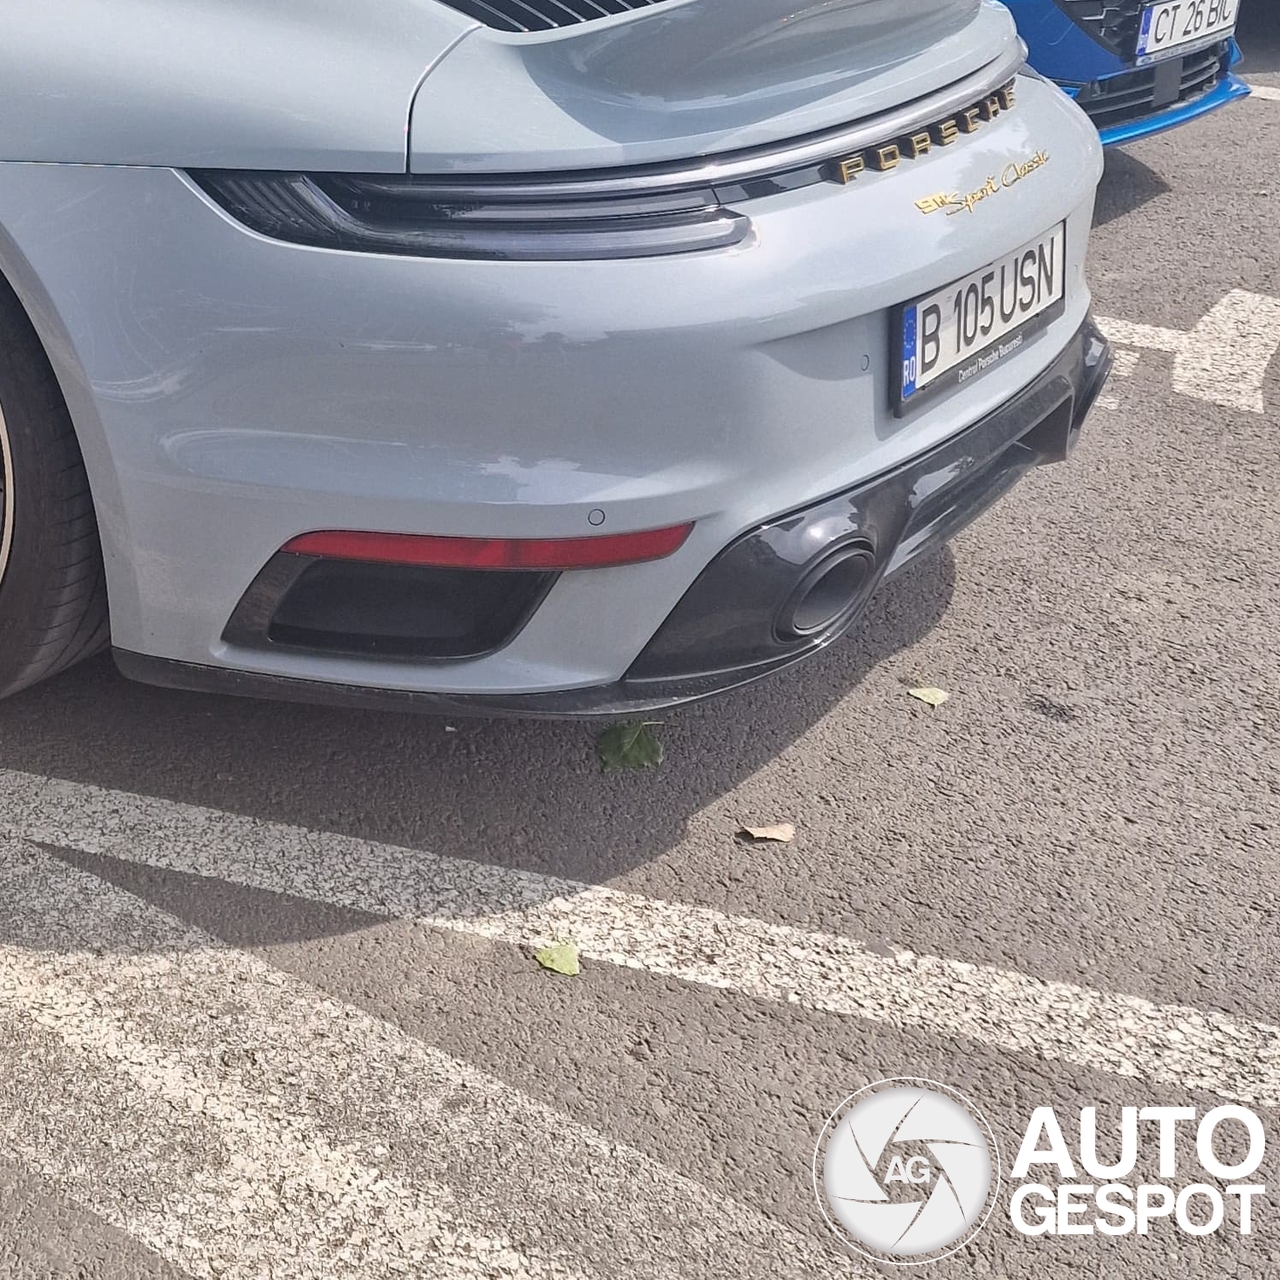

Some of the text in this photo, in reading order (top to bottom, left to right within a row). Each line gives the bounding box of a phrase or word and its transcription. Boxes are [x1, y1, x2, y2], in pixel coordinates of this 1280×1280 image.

[1154, 4, 1181, 44] CT
[838, 84, 1017, 186] PORSCHE
[945, 174, 1001, 216] Sport
[1001, 150, 1050, 187] Classic
[921, 236, 1055, 377] B 105 USN
[903, 355, 916, 387] RO
[978, 349, 999, 371] Porsche
